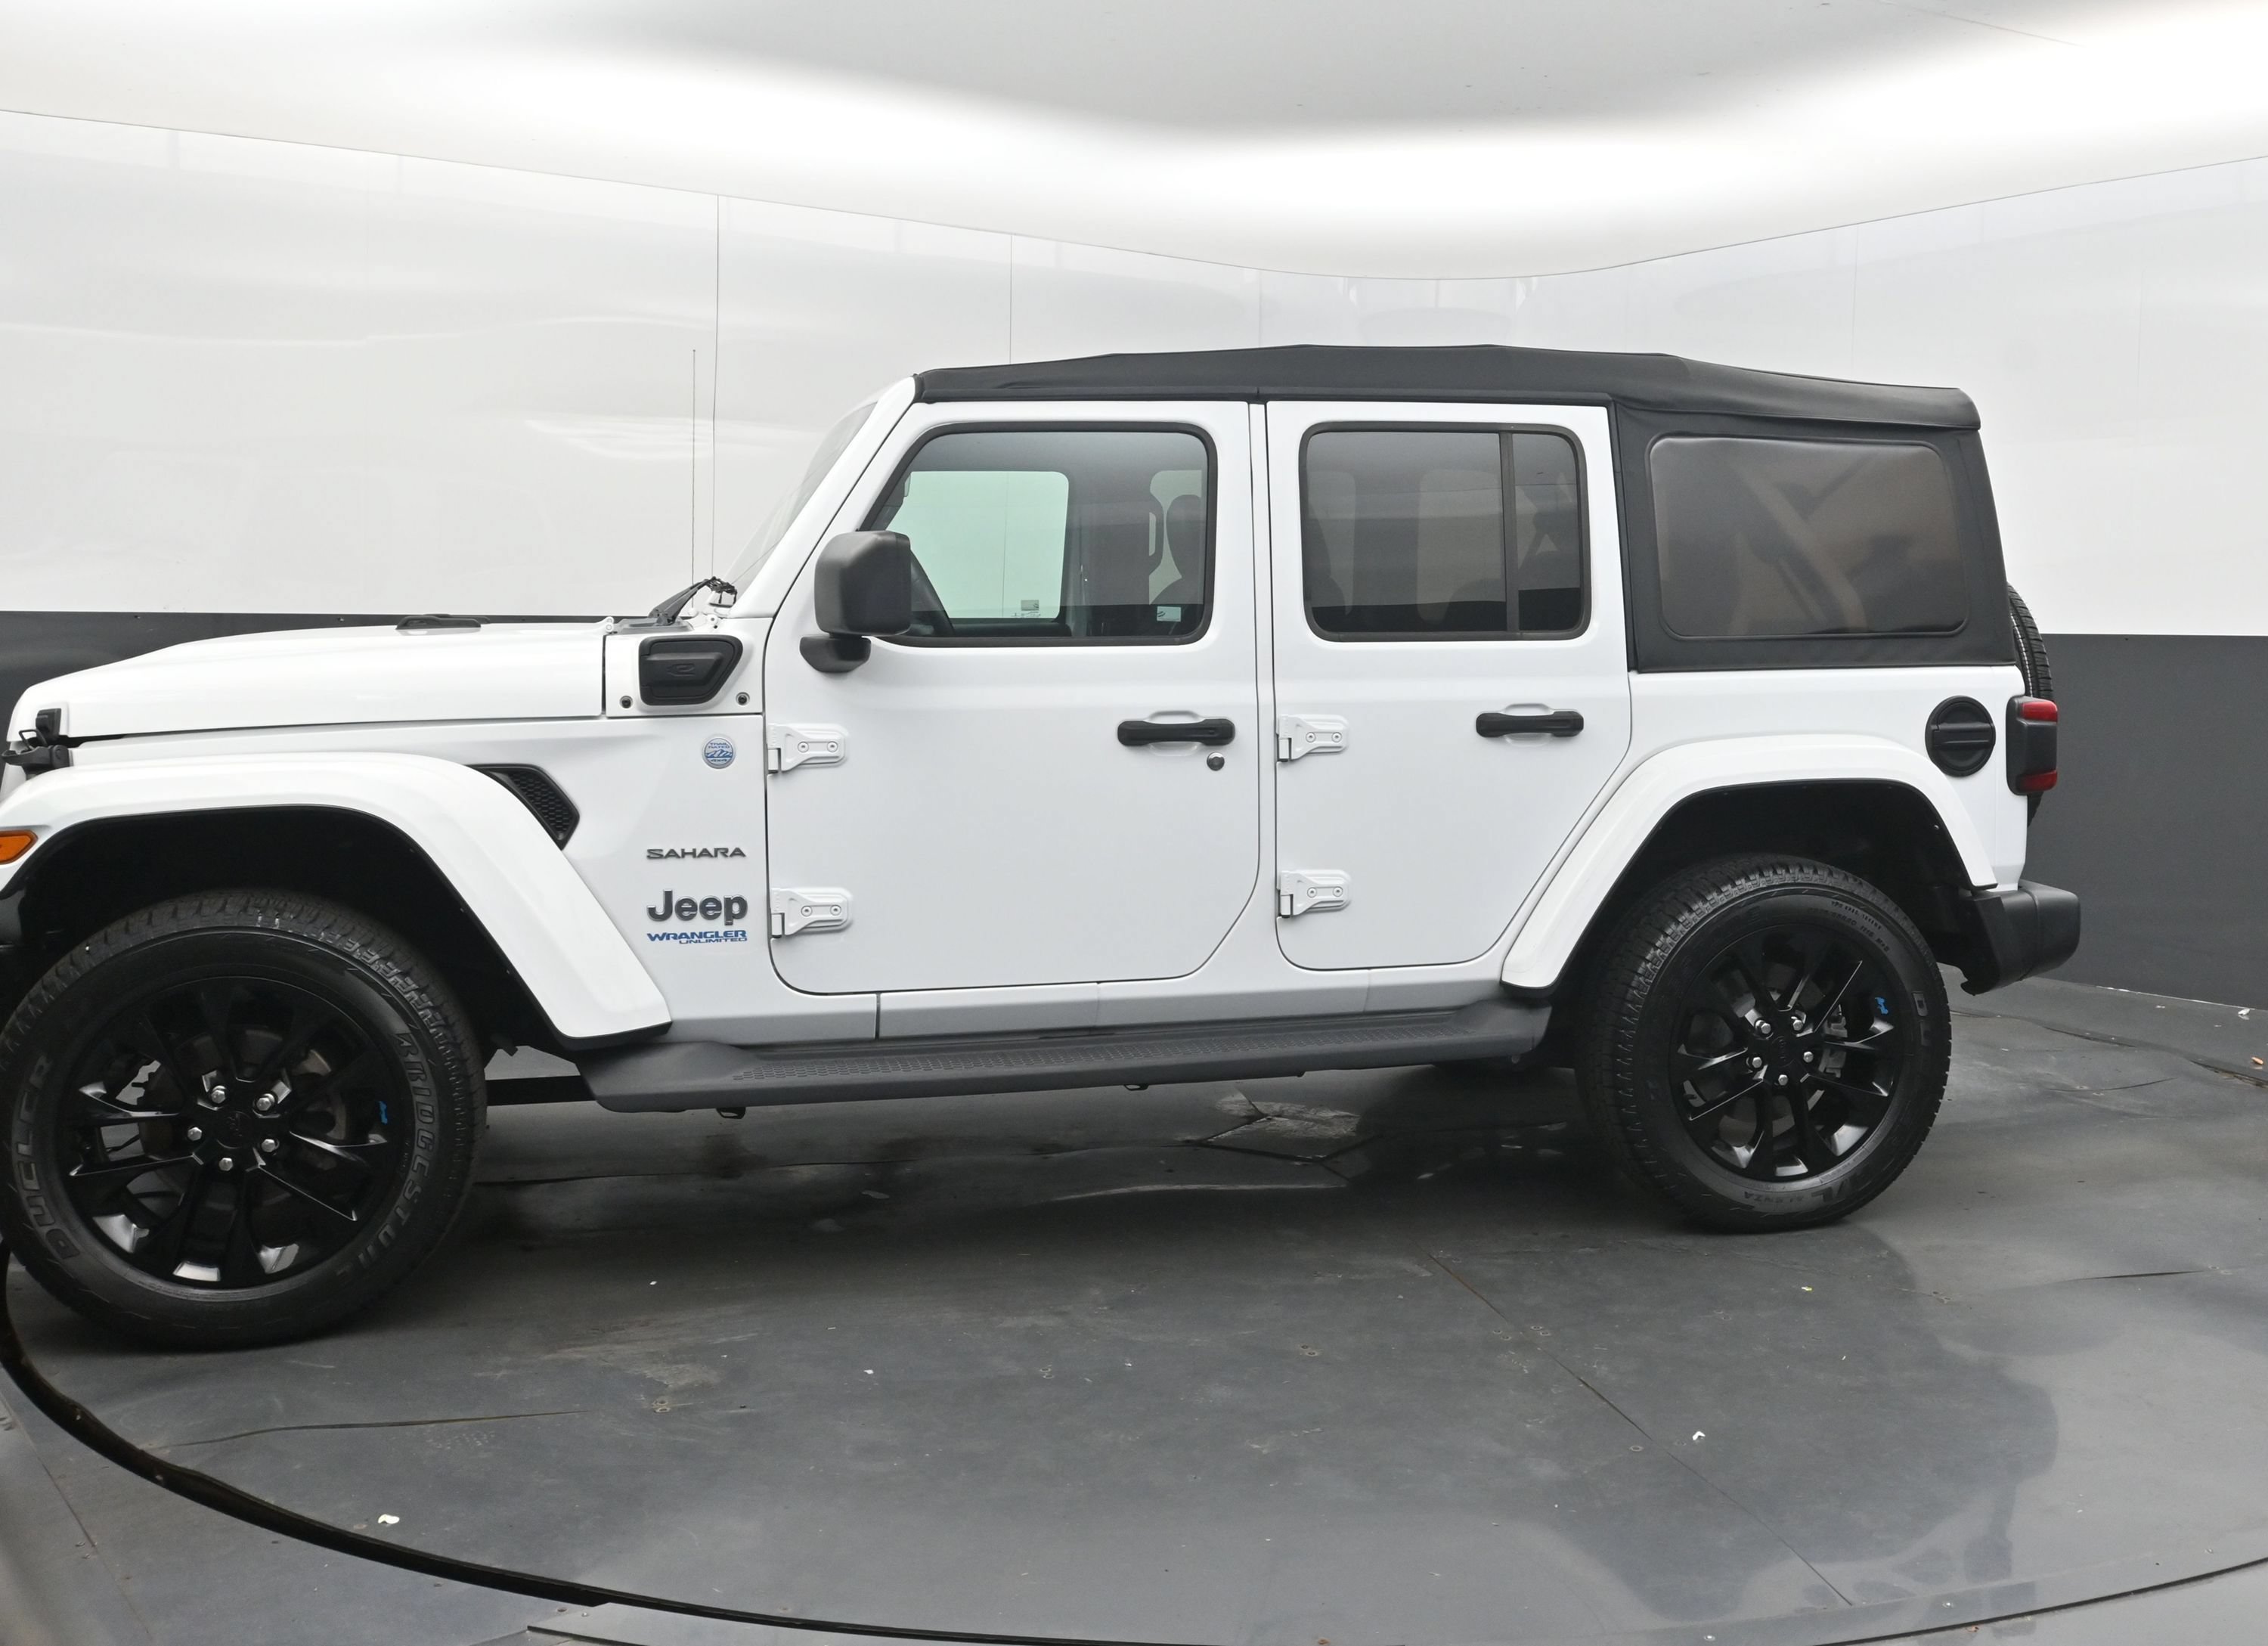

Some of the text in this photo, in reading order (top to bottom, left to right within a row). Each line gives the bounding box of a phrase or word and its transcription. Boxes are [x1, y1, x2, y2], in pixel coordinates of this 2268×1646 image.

[646, 847, 746, 860] SAHARA
[646, 888, 748, 926] Jeep
[646, 930, 747, 942] WRANGLER
[335, 1033, 435, 1278] BRIDGESTONE
